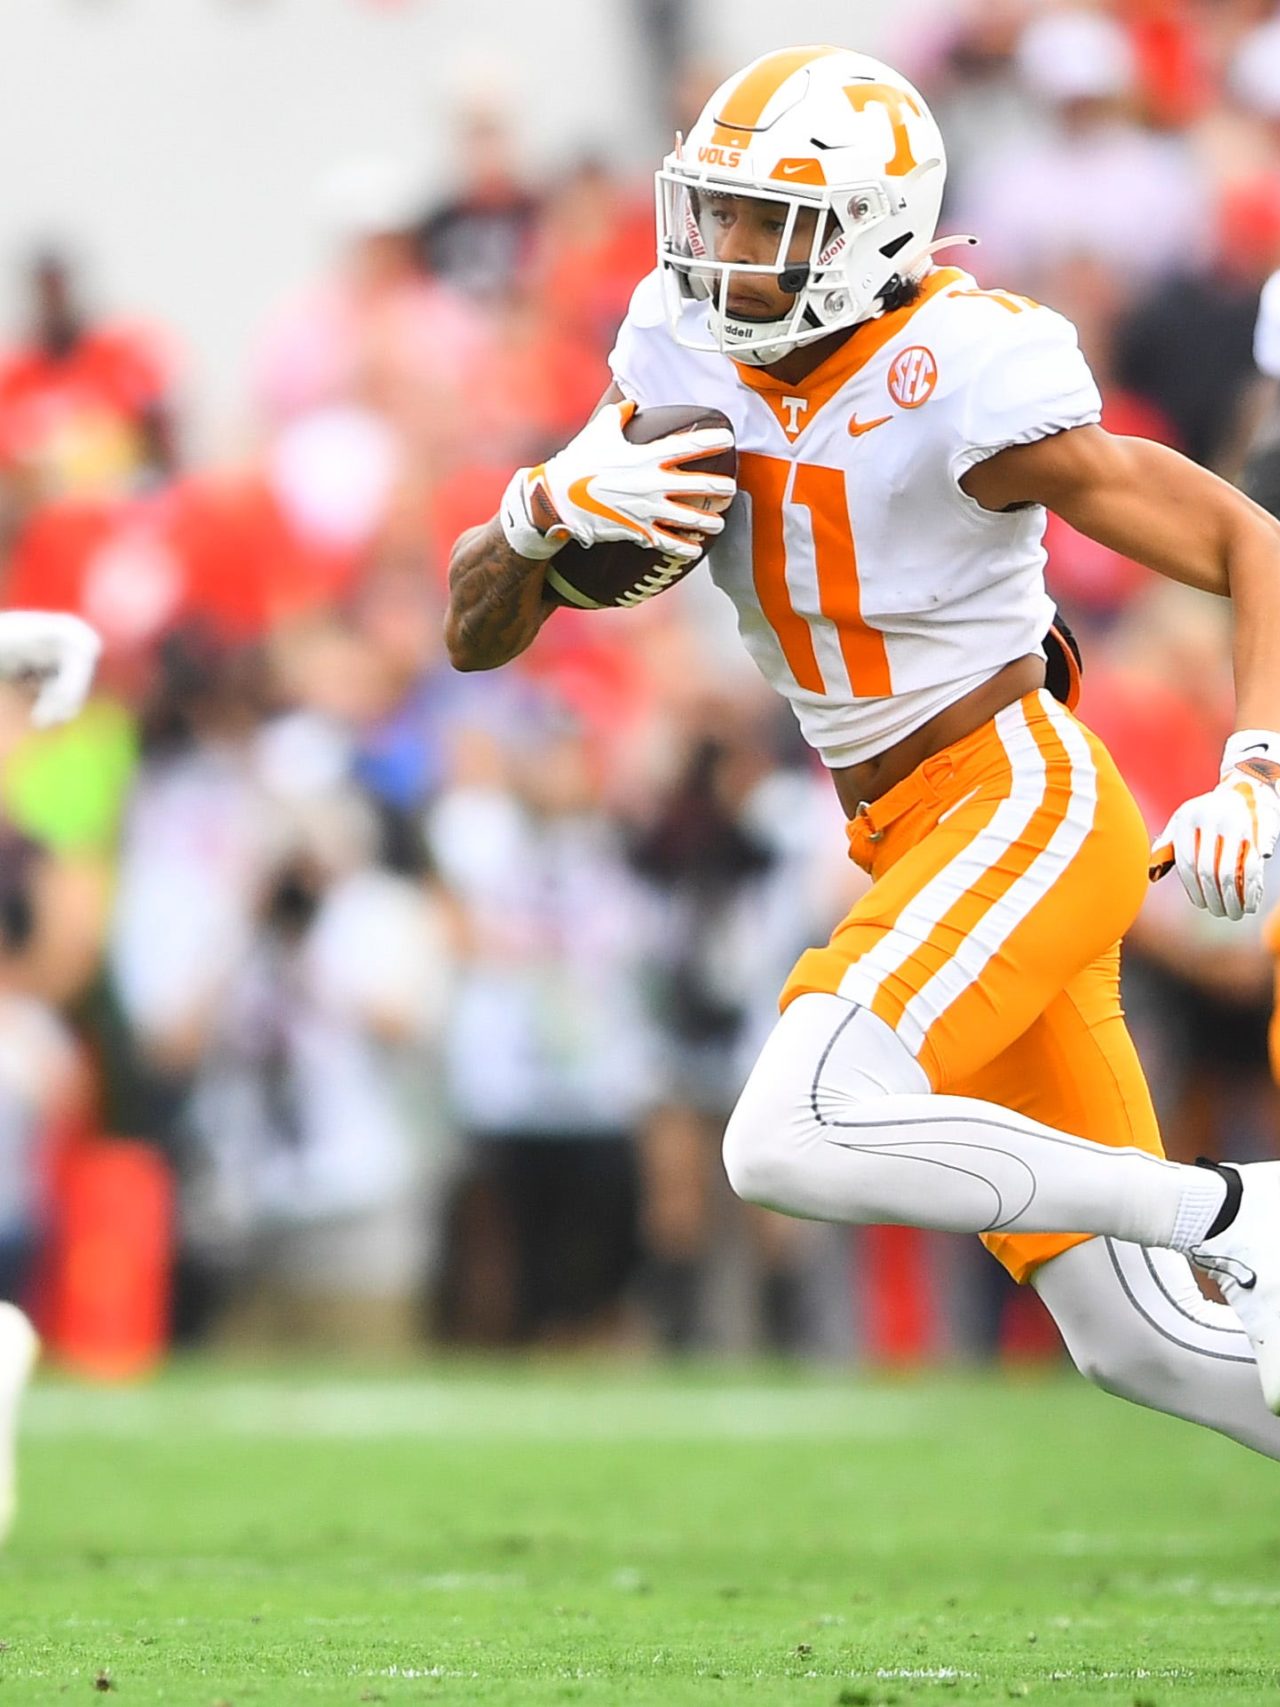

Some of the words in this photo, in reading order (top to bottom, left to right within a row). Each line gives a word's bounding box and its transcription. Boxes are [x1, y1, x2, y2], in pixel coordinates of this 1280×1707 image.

[698, 147, 741, 168] VOLS
[818, 238, 846, 266] ddell
[725, 324, 753, 338] ddell
[891, 349, 934, 404] SEC
[782, 396, 808, 433] T
[738, 452, 893, 698] 11
